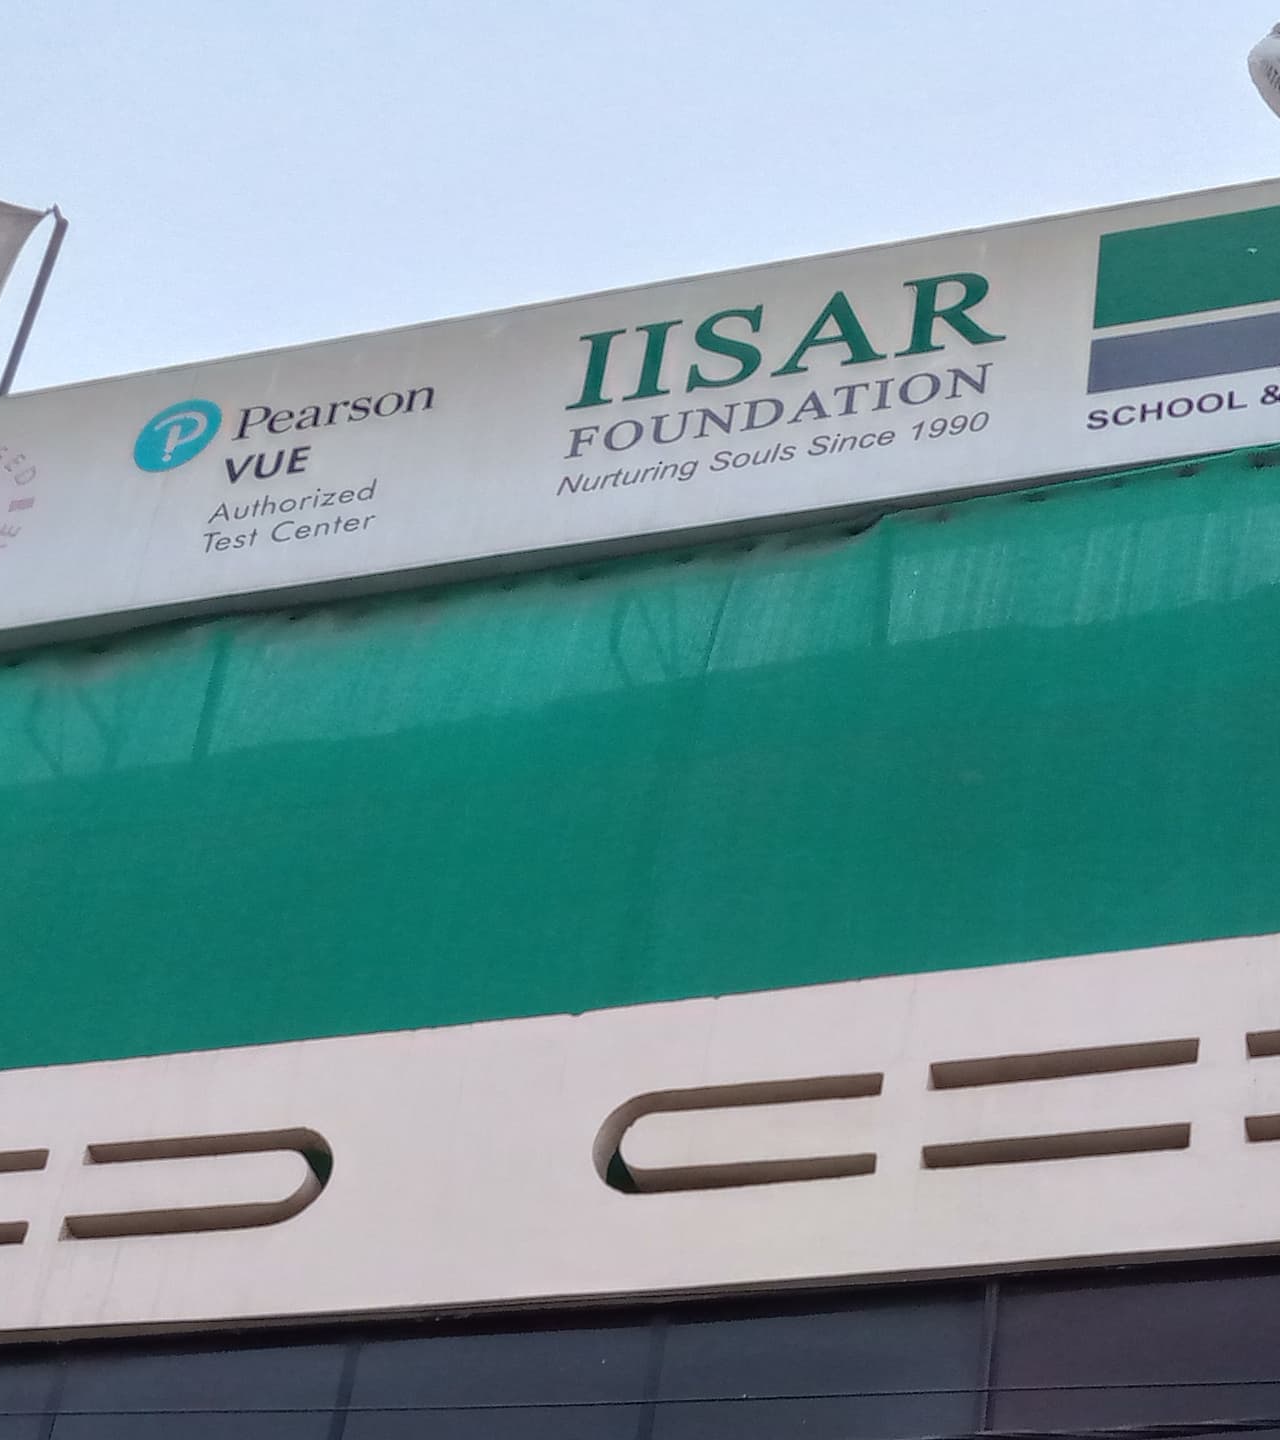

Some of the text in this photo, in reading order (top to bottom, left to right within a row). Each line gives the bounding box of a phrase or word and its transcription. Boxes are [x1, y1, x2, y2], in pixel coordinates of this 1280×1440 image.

[565, 271, 1007, 410] IISAR
[231, 385, 435, 442] Pearson
[564, 362, 994, 459] FOUNDATION
[1086, 389, 1248, 432] SCHOOL
[223, 446, 311, 485] VUE
[556, 410, 990, 497] Nurturing Souls Since 1990
[207, 479, 376, 525] Authorized
[202, 511, 376, 555] Test Center
